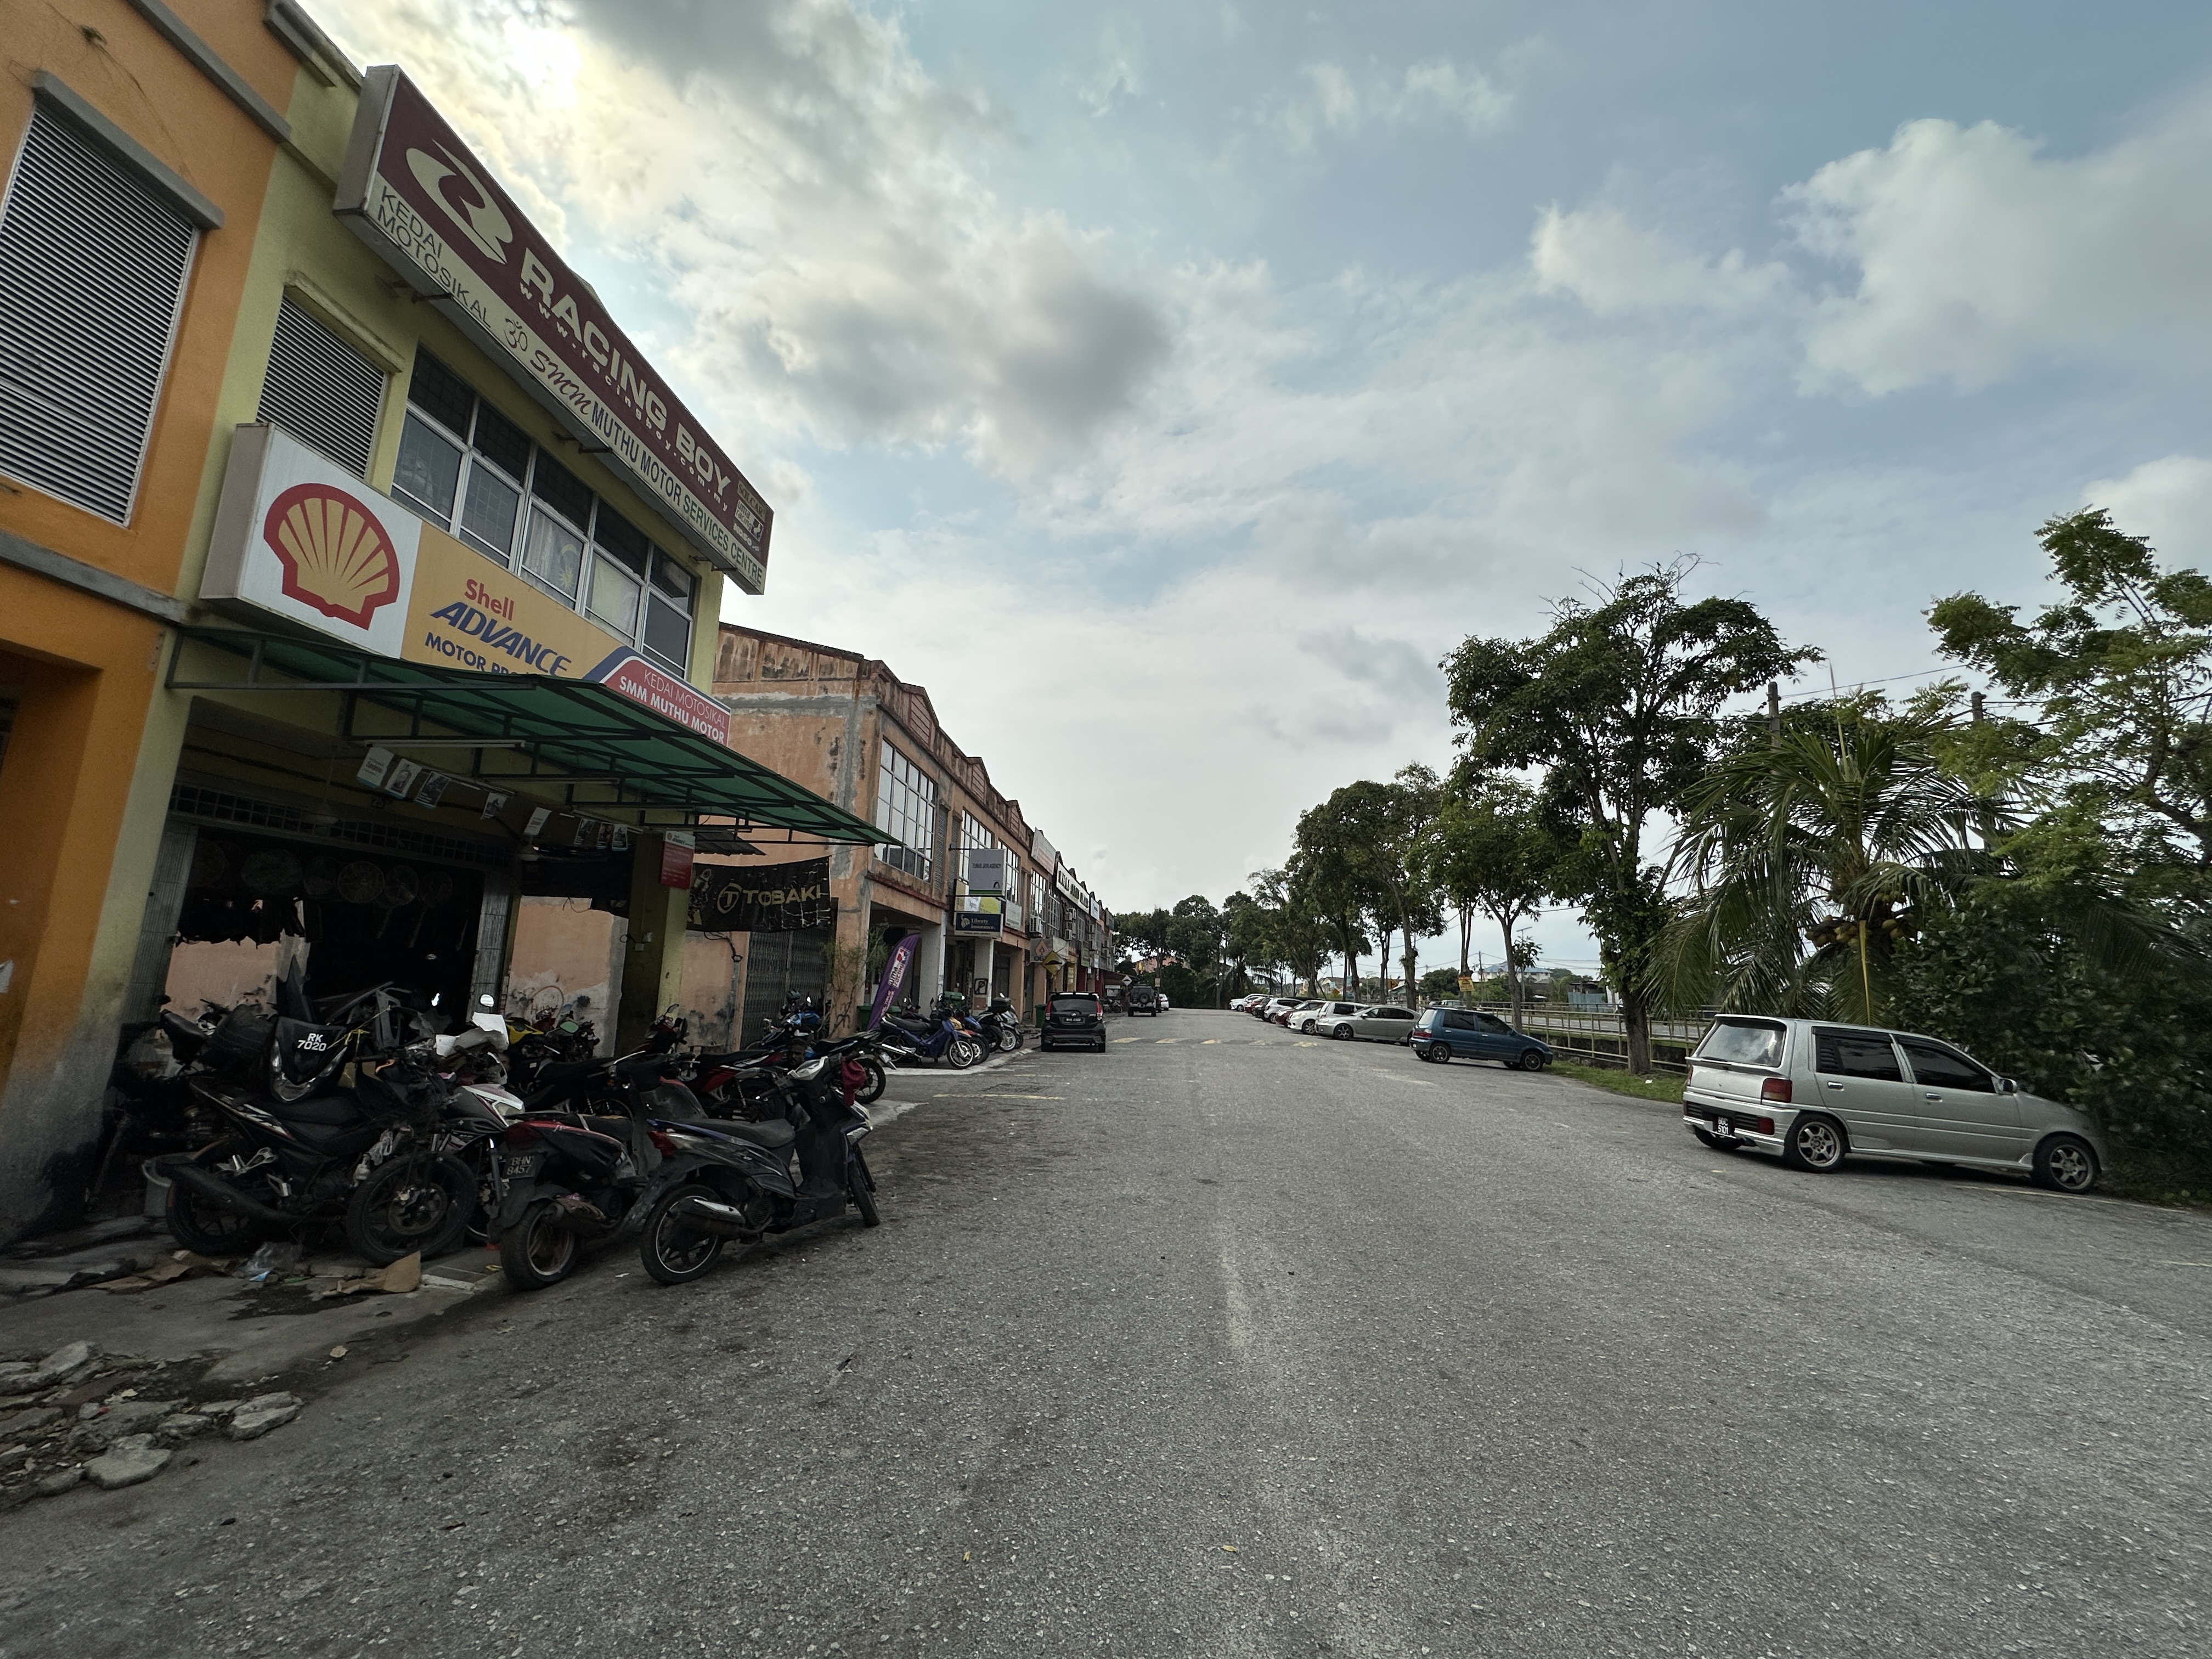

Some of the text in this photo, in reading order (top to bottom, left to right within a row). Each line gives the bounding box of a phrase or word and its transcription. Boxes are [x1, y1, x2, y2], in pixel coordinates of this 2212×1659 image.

[382, 186, 442, 258] KEDAI
[379, 205, 493, 328] MOTOSIKAL
[521, 247, 731, 496] RACING BOY
[520, 283, 728, 512] www.racingboy.com.my
[591, 400, 639, 463] MUTHU
[640, 455, 681, 506] MOTOR
[682, 494, 729, 551] SERVICES
[731, 542, 763, 585] CENTRE
[738, 502, 751, 518] uma
[736, 510, 752, 531] racing
[464, 579, 514, 621] Shell
[425, 632, 486, 672] MOTOR
[430, 602, 571, 676] ADVANCE
[619, 676, 725, 744] SMM MUTHU MOTOR
[644, 669, 725, 729] KEDAI MOTOSIKAL
[742, 884, 821, 906] TOBAKI
[297, 1040, 326, 1051] 7020
[307, 1033, 323, 1042] RK
[506, 1164, 532, 1175] 8457
[511, 1155, 531, 1166] BHN
